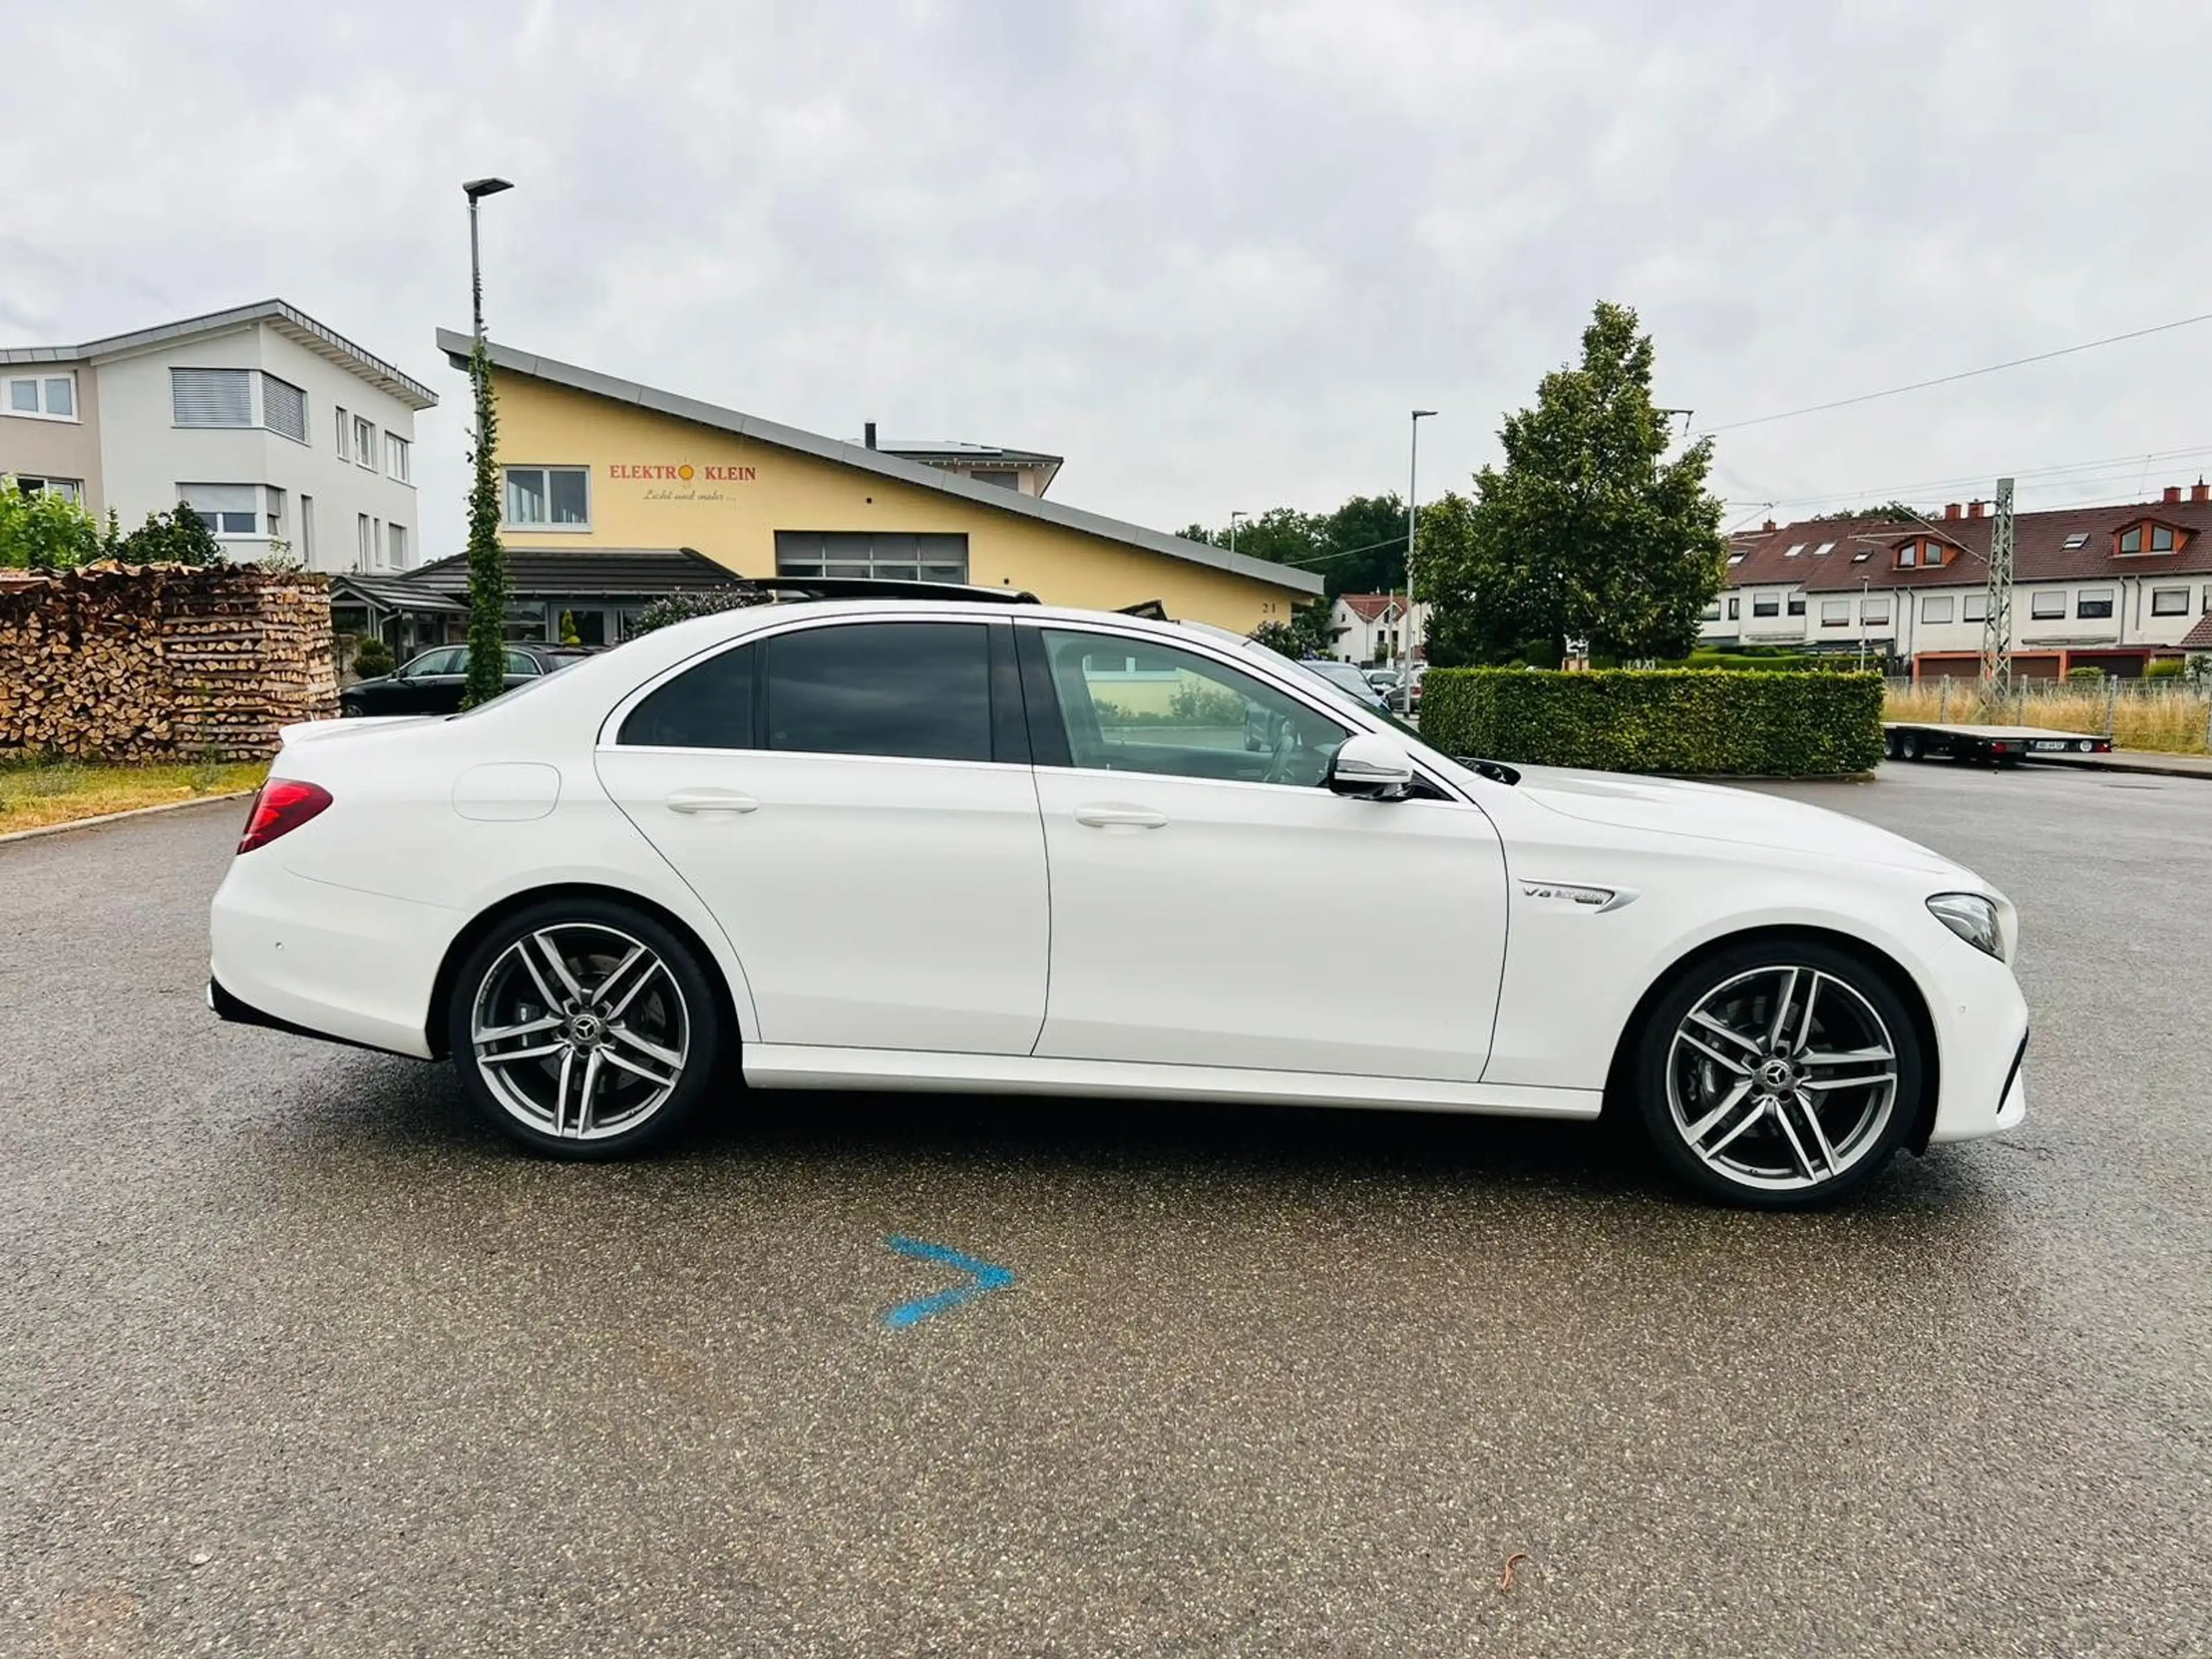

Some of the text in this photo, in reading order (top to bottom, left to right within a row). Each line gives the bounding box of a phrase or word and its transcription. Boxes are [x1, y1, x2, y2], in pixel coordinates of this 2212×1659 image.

[609, 464, 756, 480] ELEKTRO KLEIN
[675, 490, 695, 500] und
